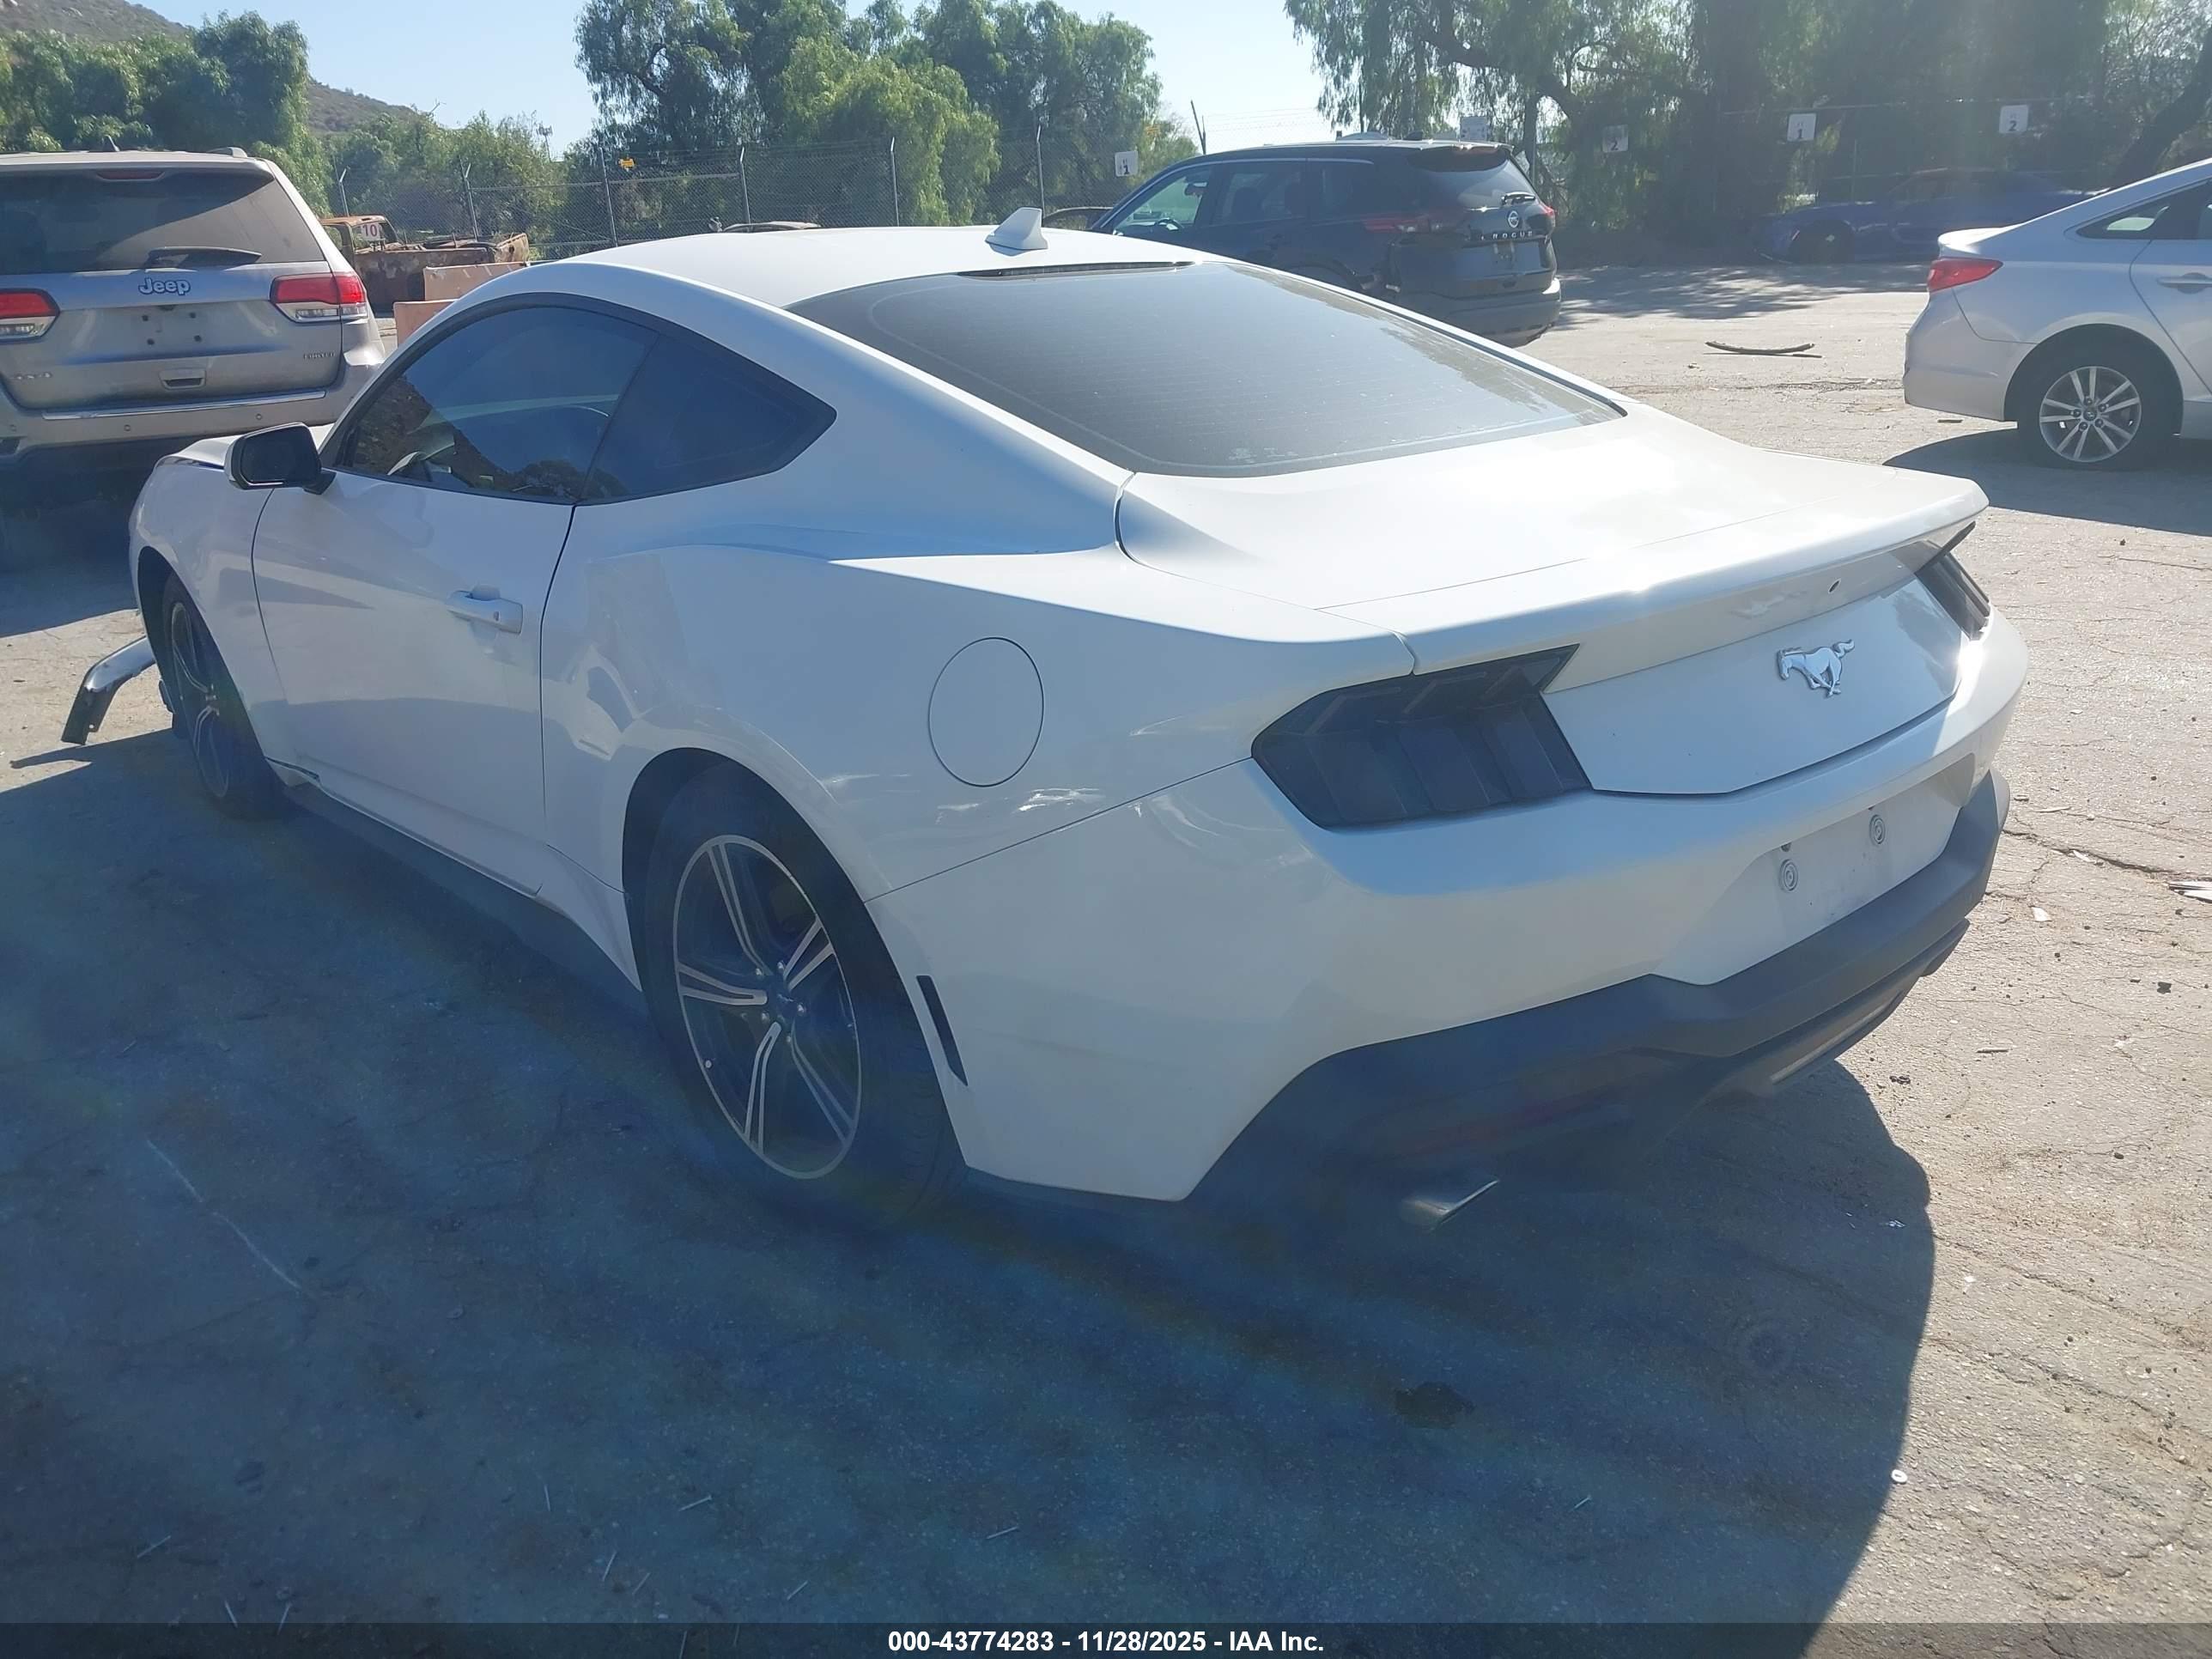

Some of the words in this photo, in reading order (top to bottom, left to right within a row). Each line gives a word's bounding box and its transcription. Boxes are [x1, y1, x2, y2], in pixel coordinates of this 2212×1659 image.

[2008, 120, 2017, 131] 2
[362, 224, 378, 237] 10
[1492, 230, 1533, 240] ROGUE
[138, 277, 191, 295] Jeep
